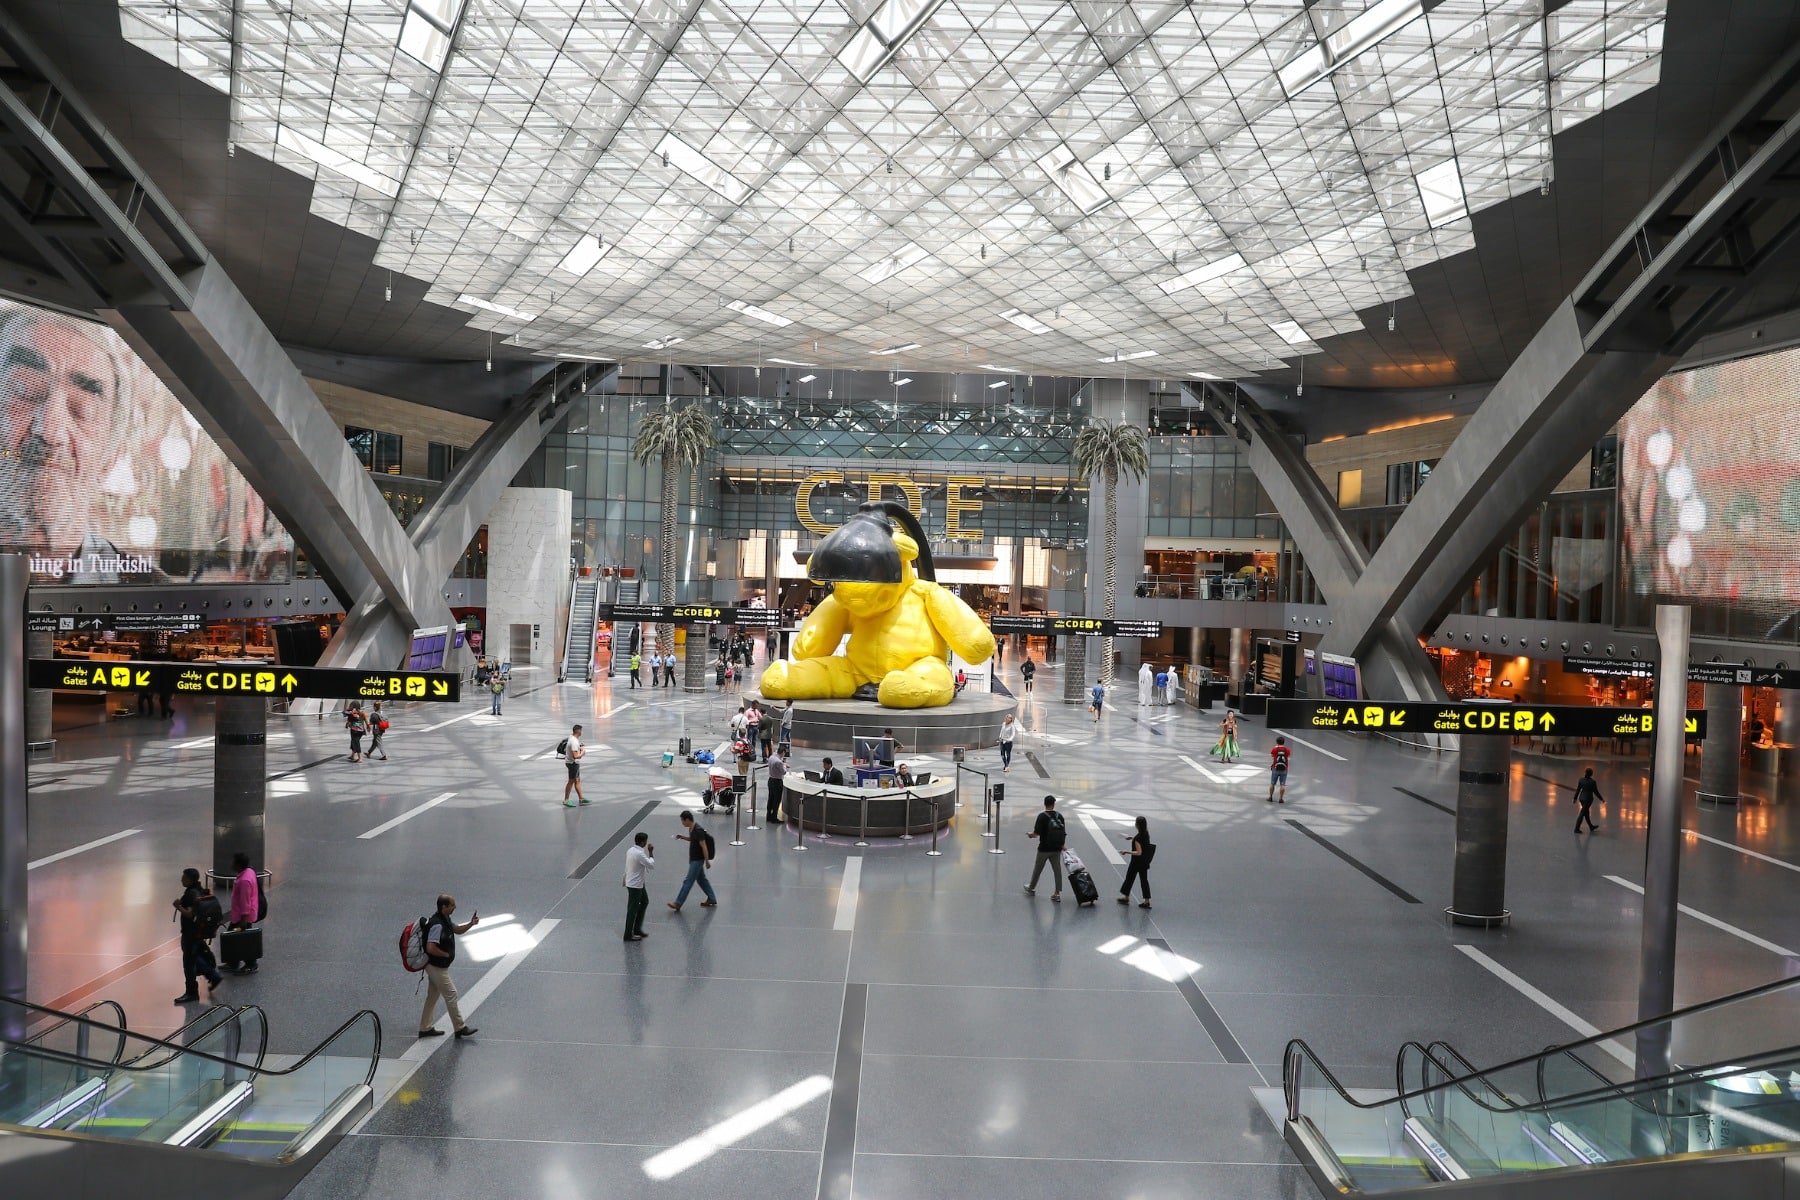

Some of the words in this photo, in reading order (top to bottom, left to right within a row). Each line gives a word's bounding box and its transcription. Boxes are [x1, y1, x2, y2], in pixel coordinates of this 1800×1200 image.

[67, 553, 84, 573] in
[88, 554, 153, 573] Turkish!
[684, 608, 703, 617] CDE
[1065, 620, 1085, 628] CDE
[67, 666, 88, 676] بوابات
[181, 670, 202, 680] بوابات
[63, 676, 88, 686] Gates
[92, 668, 107, 684] A
[363, 676, 385, 686] بوابات
[1709, 675, 1733, 683] Lounge
[177, 680, 202, 690] Gates
[360, 686, 385, 696] Gates
[389, 678, 401, 694] B
[1316, 705, 1338, 716] بوابات
[1438, 710, 1460, 720] بوابات
[1312, 716, 1338, 726] Gates
[1342, 708, 1359, 724] A
[1617, 713, 1638, 724] بوابات
[1434, 720, 1460, 730] Gates
[1613, 724, 1638, 734] Gates
[1641, 715, 1653, 732] B
